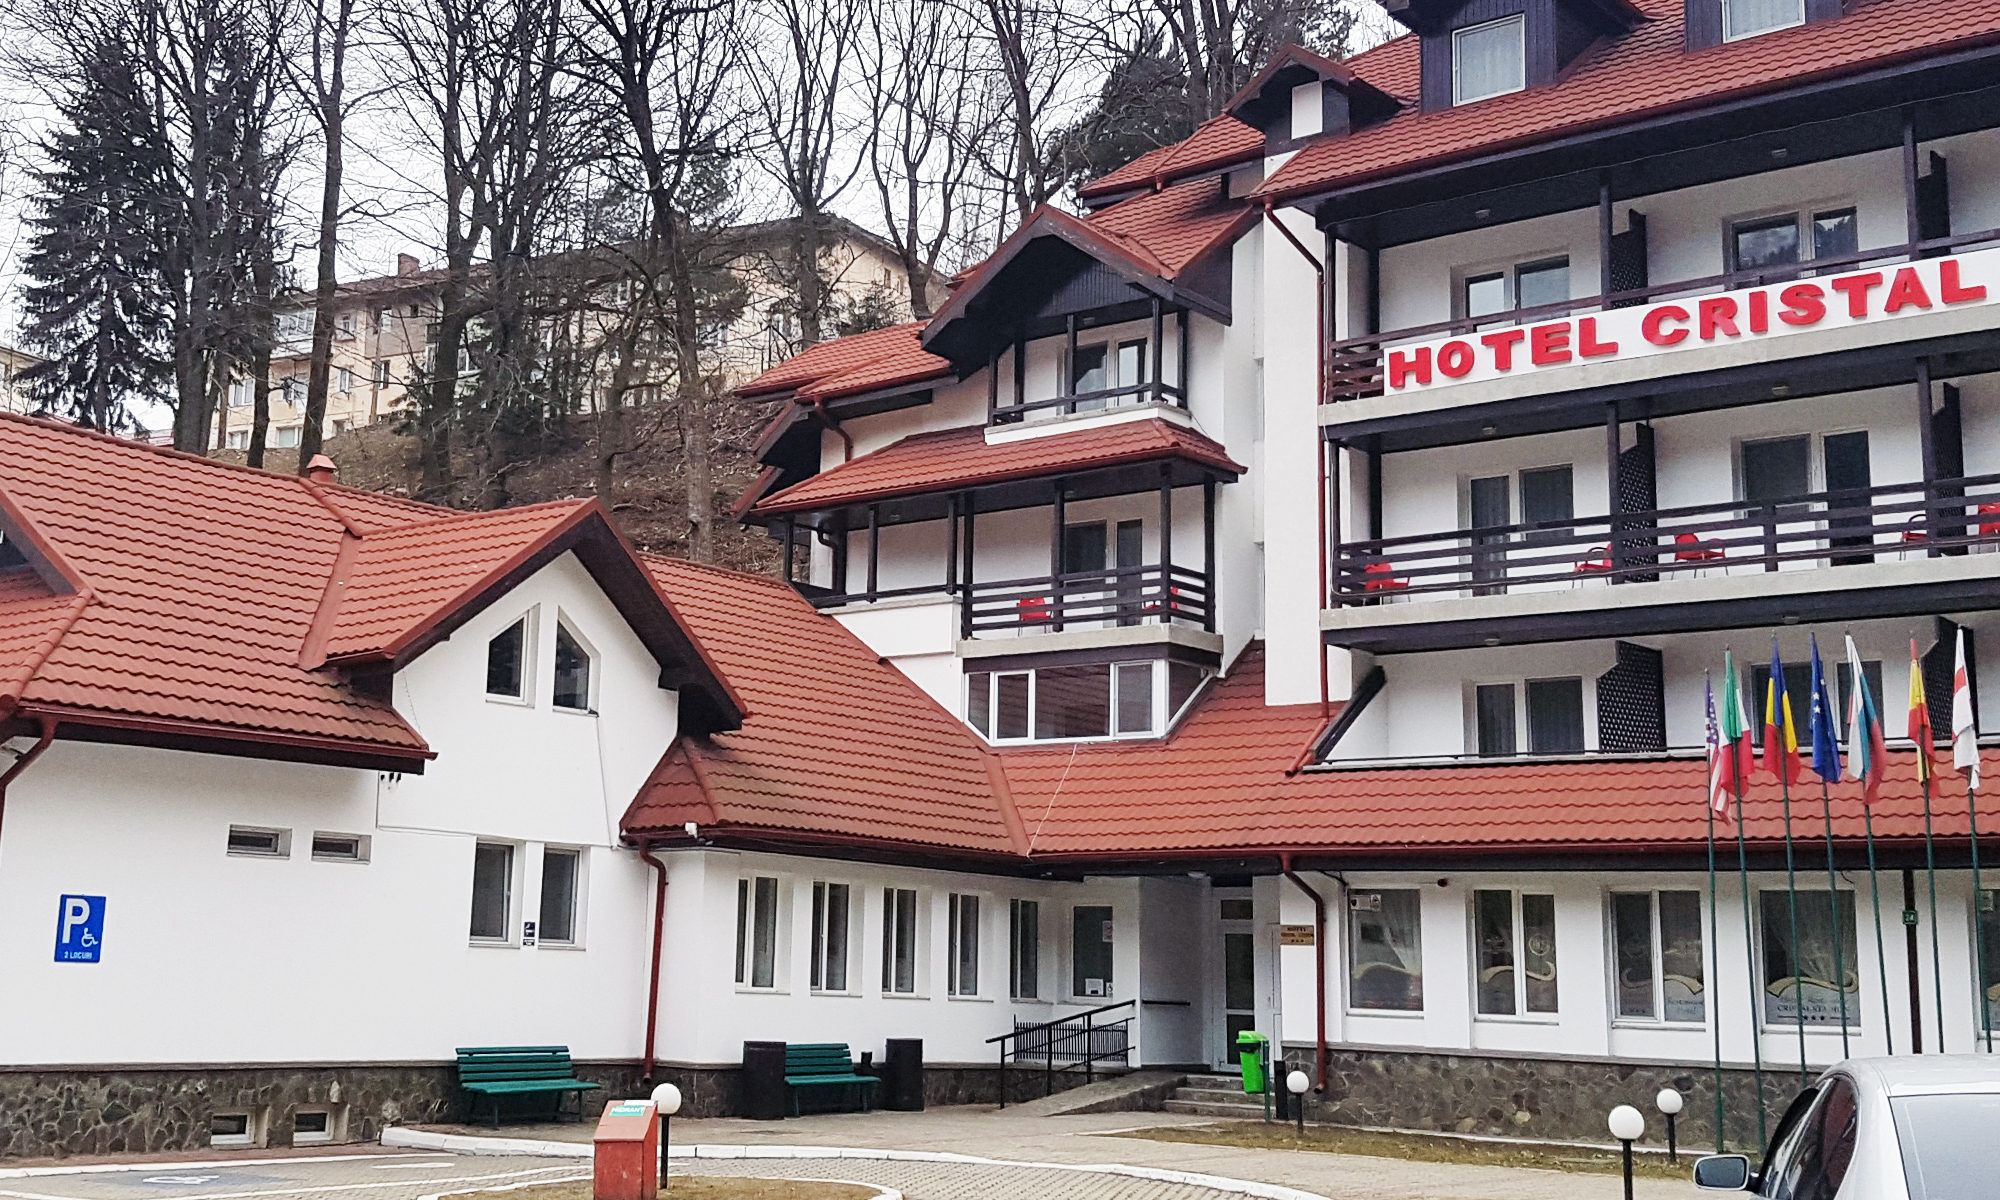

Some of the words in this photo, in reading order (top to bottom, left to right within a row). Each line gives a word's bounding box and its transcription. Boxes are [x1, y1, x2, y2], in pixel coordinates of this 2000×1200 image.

[1389, 316, 1619, 389] HOTEL
[1641, 259, 1988, 346] CRISTAL
[62, 897, 90, 943] P
